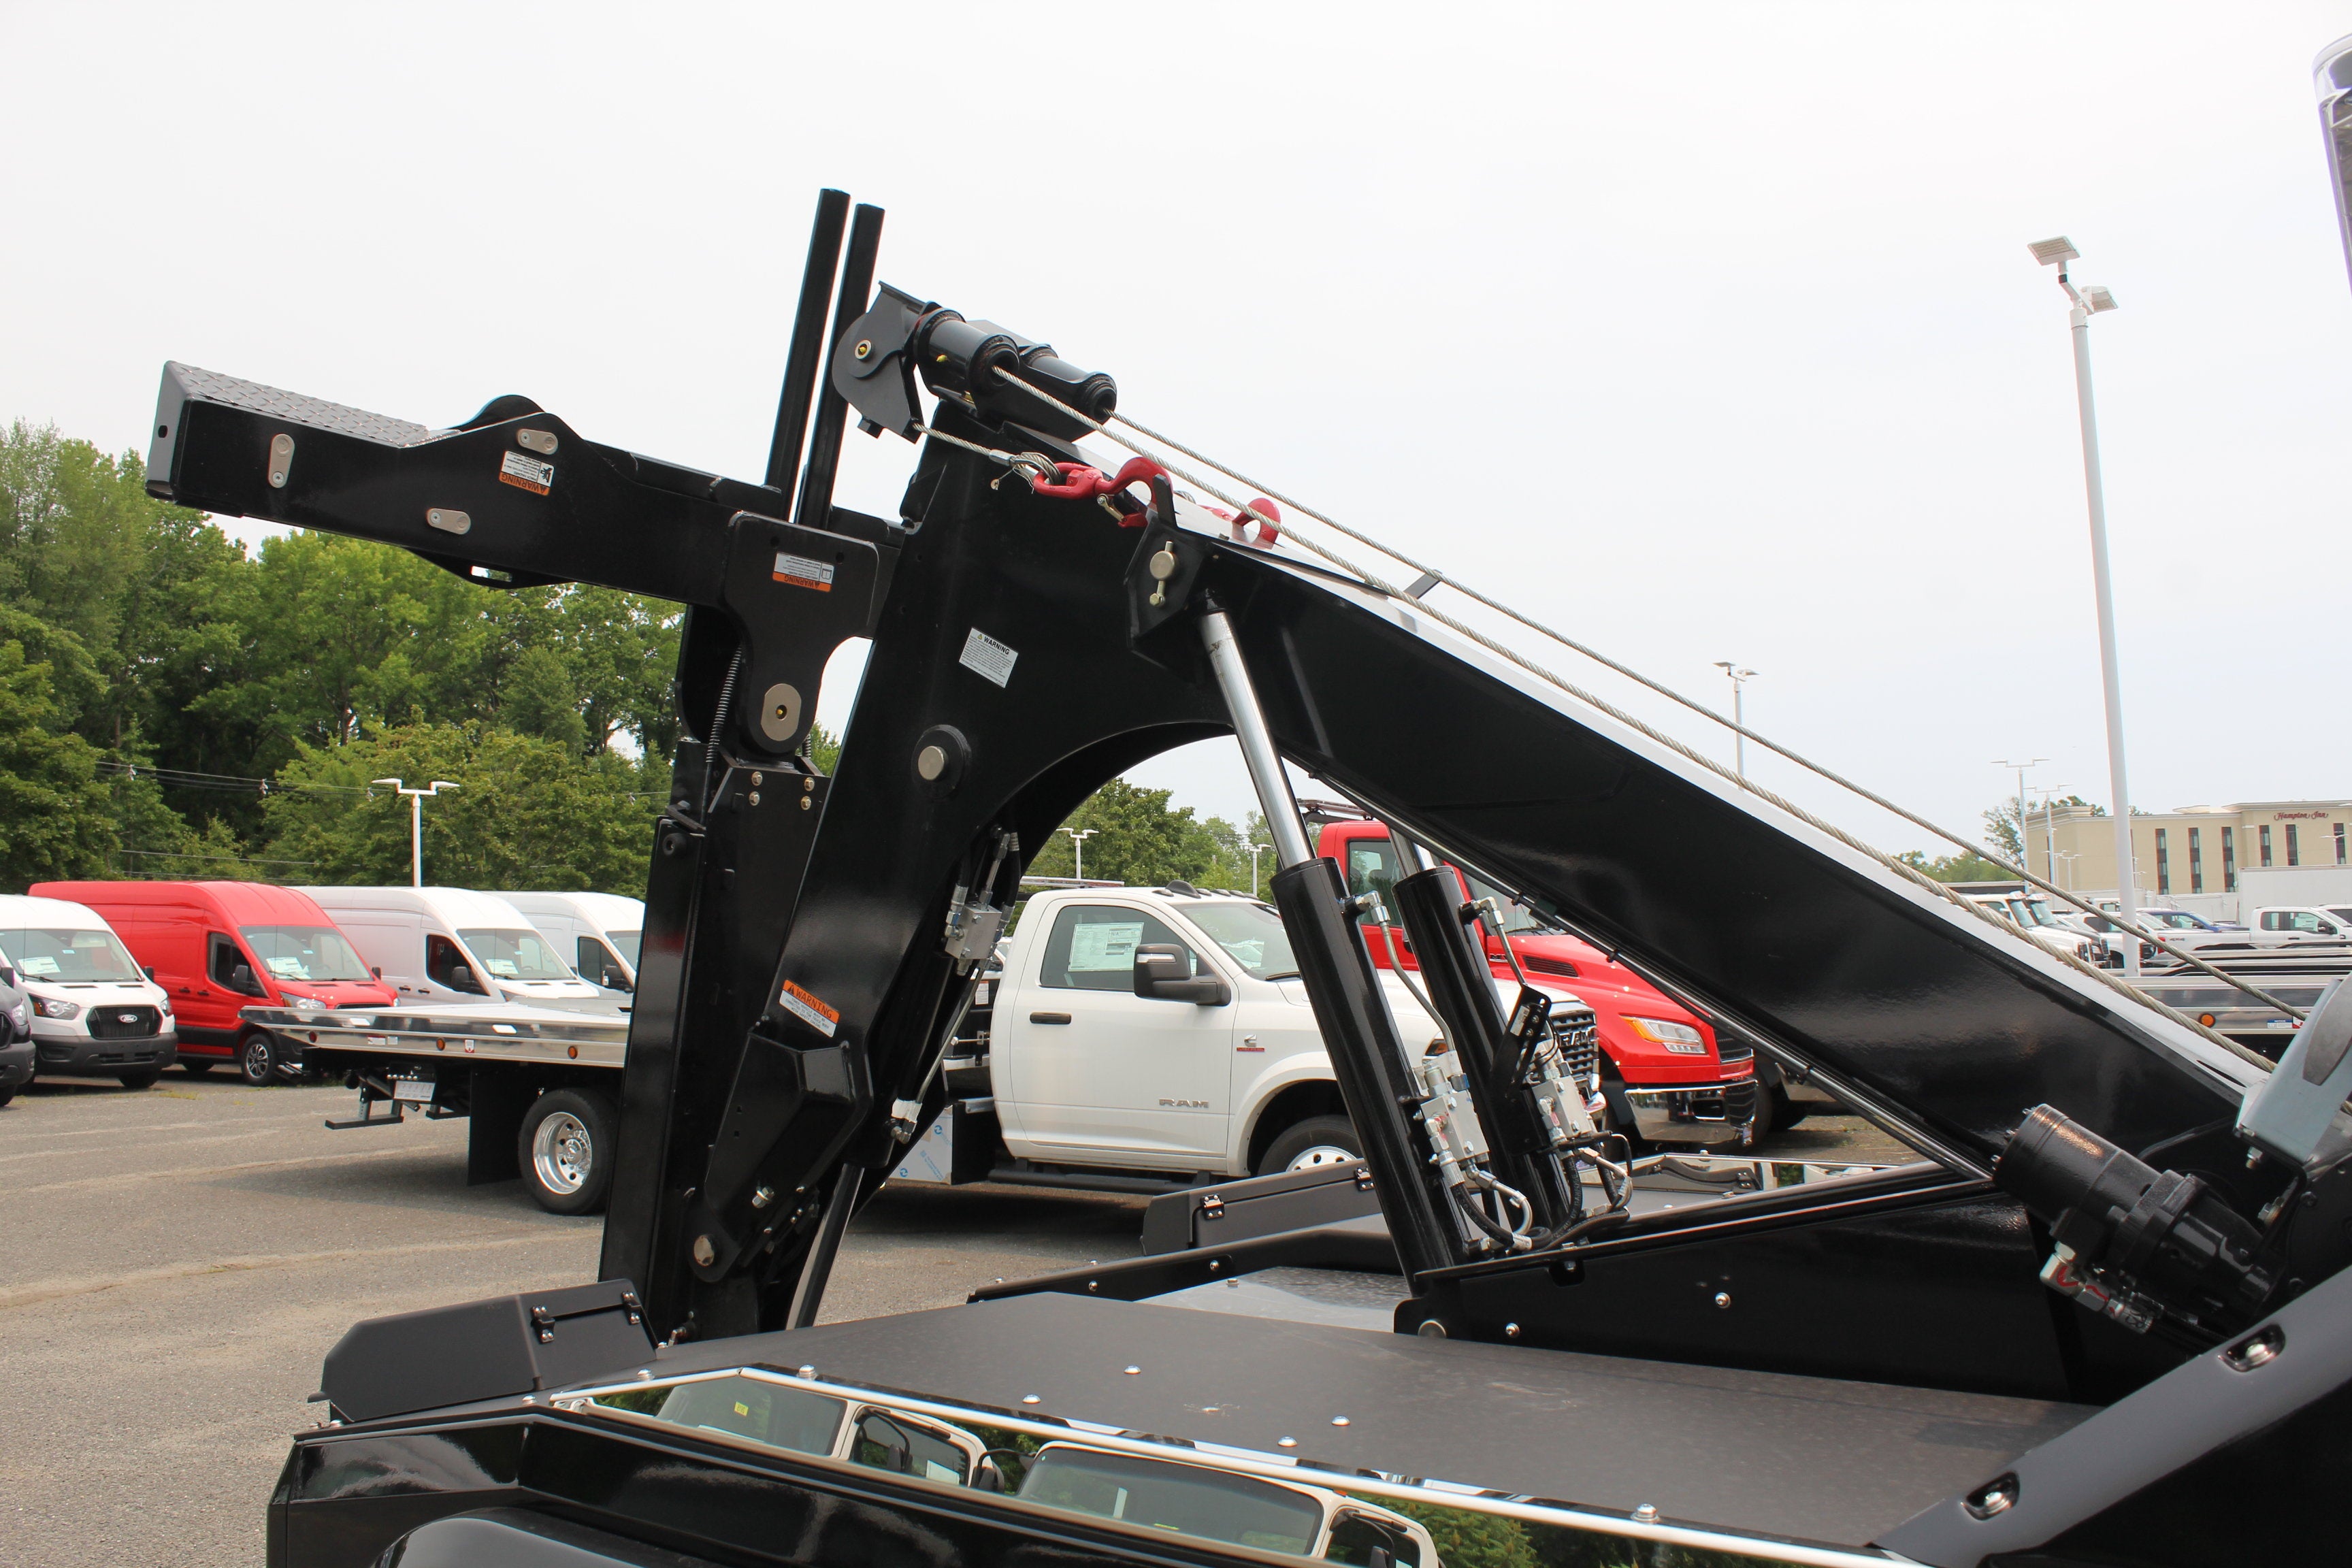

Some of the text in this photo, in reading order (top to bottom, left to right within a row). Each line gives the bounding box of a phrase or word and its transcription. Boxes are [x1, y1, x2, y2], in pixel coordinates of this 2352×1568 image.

[502, 474, 539, 491] WARNING
[785, 575, 814, 587] WARNING
[984, 636, 1010, 655] WARNING
[2274, 811, 2329, 821] Hampton Inn
[796, 988, 832, 1018] WARNING
[1159, 1098, 1209, 1108] RAM
